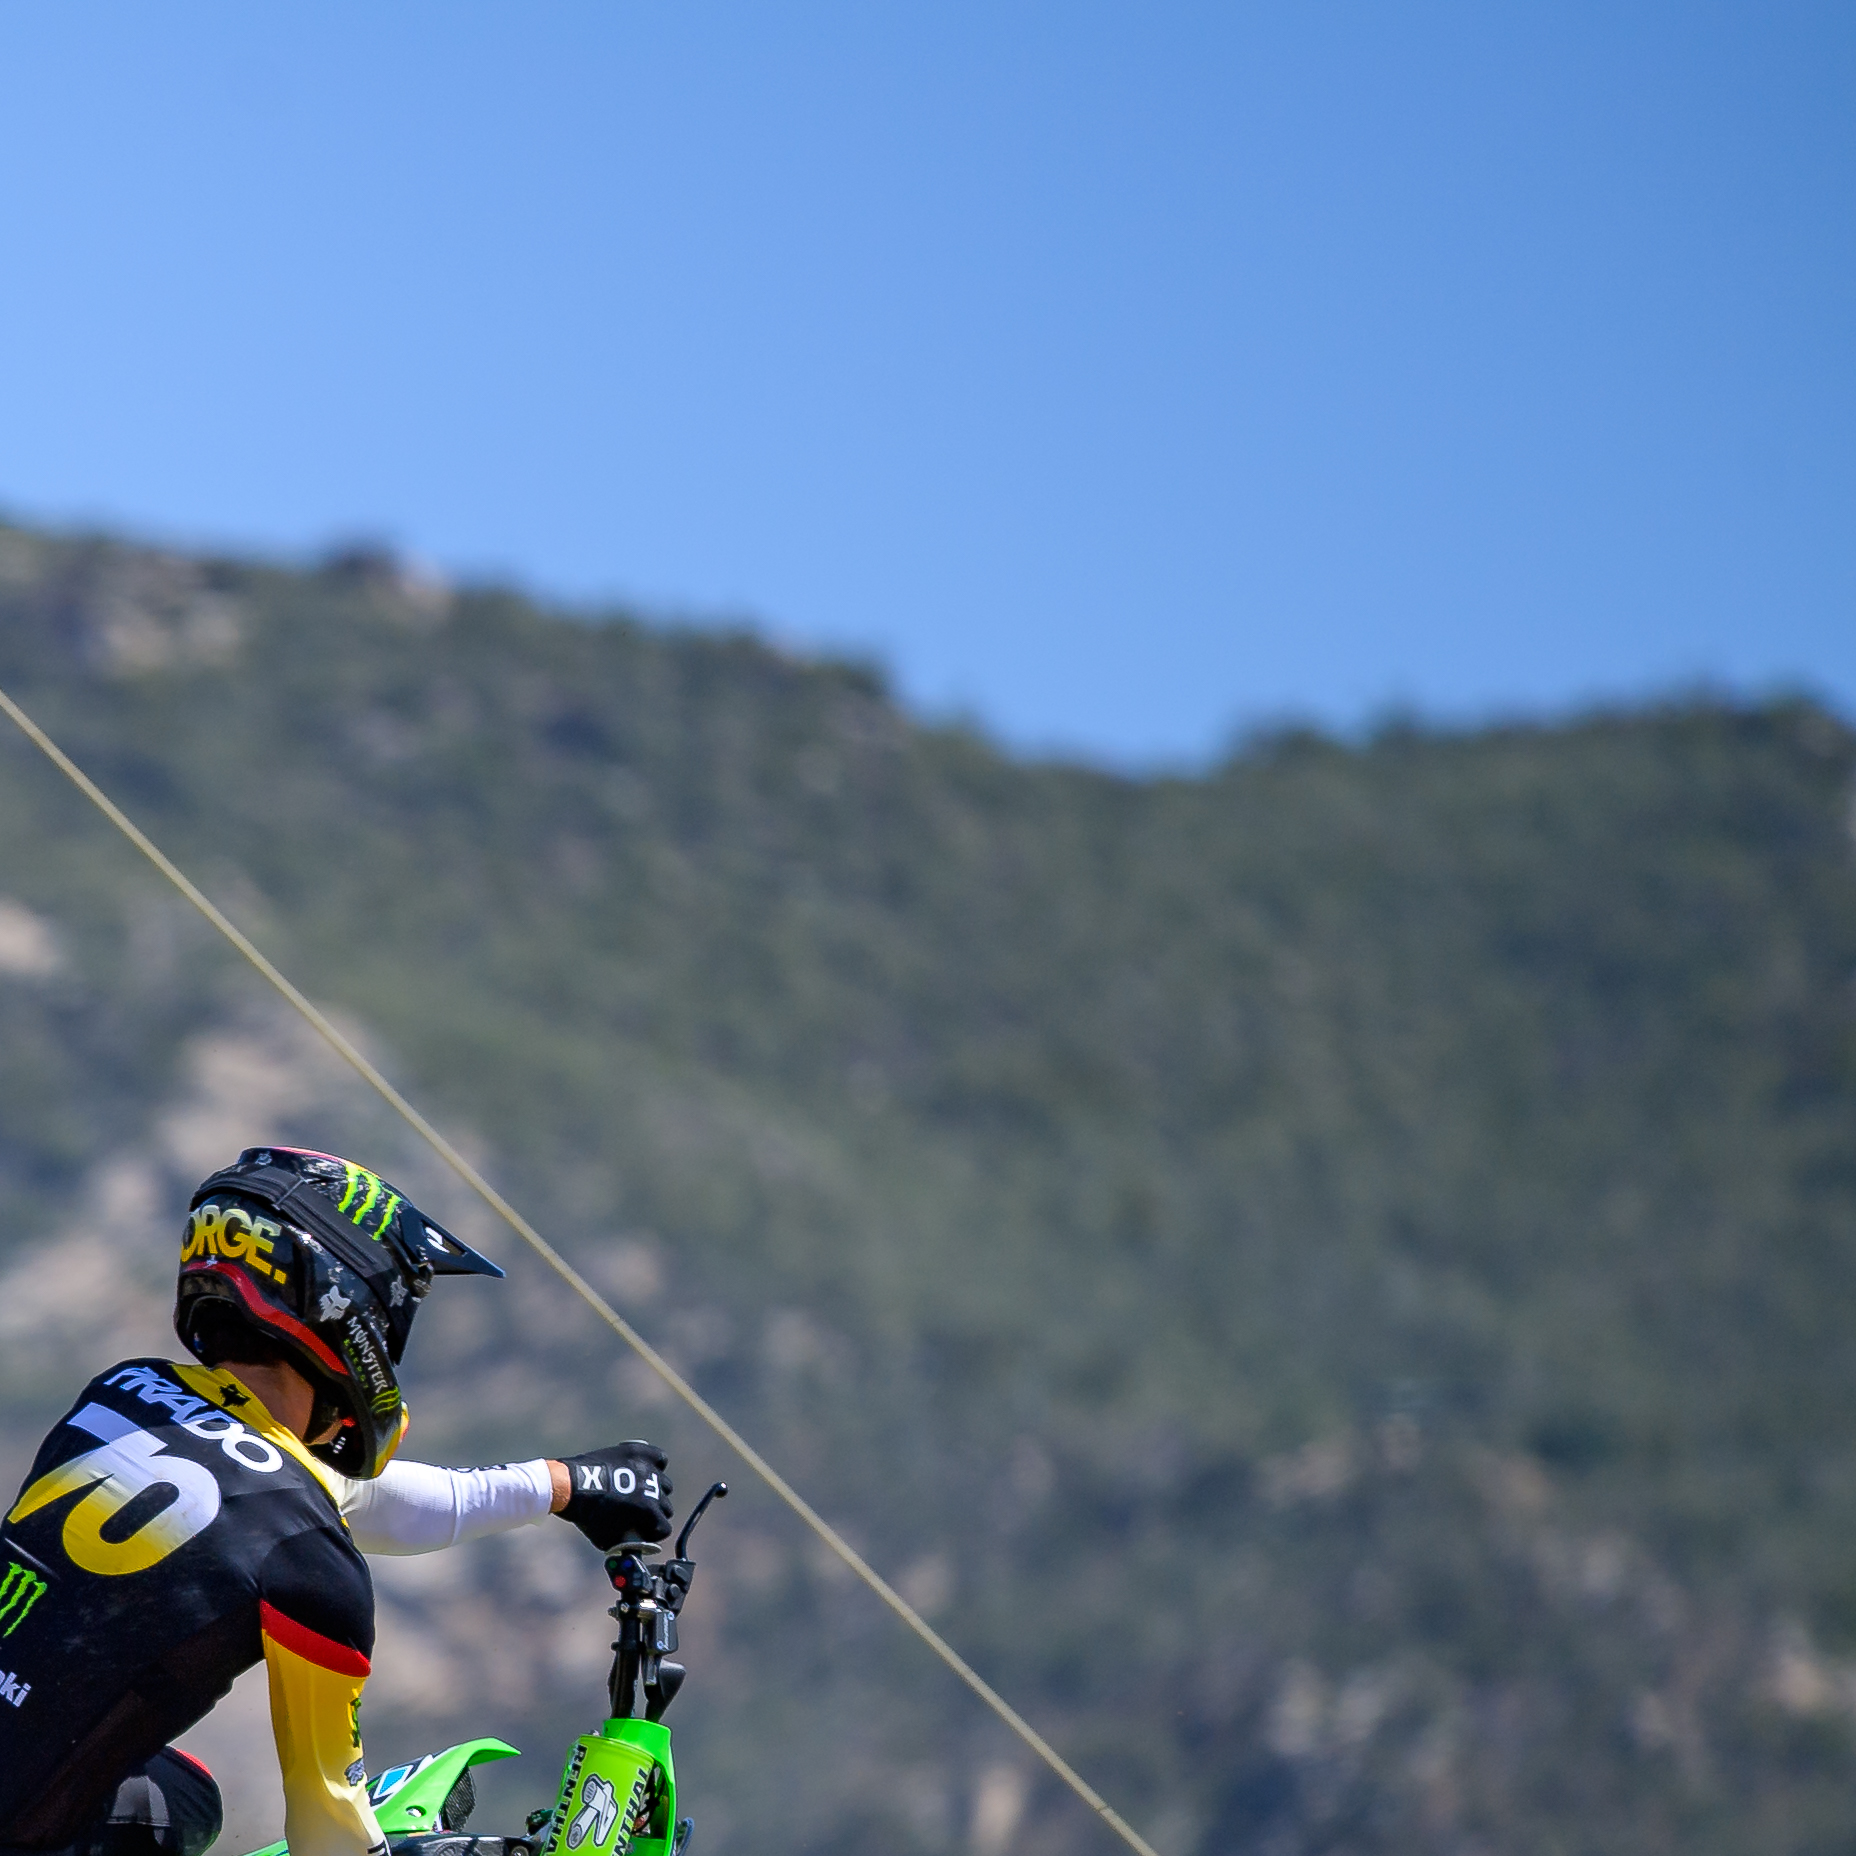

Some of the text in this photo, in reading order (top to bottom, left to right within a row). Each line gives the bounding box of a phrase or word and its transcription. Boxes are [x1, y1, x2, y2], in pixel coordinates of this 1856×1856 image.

[347, 1316, 388, 1394] MONSTER
[7, 1402, 221, 1576] 70
[581, 1465, 661, 1500] FOX
